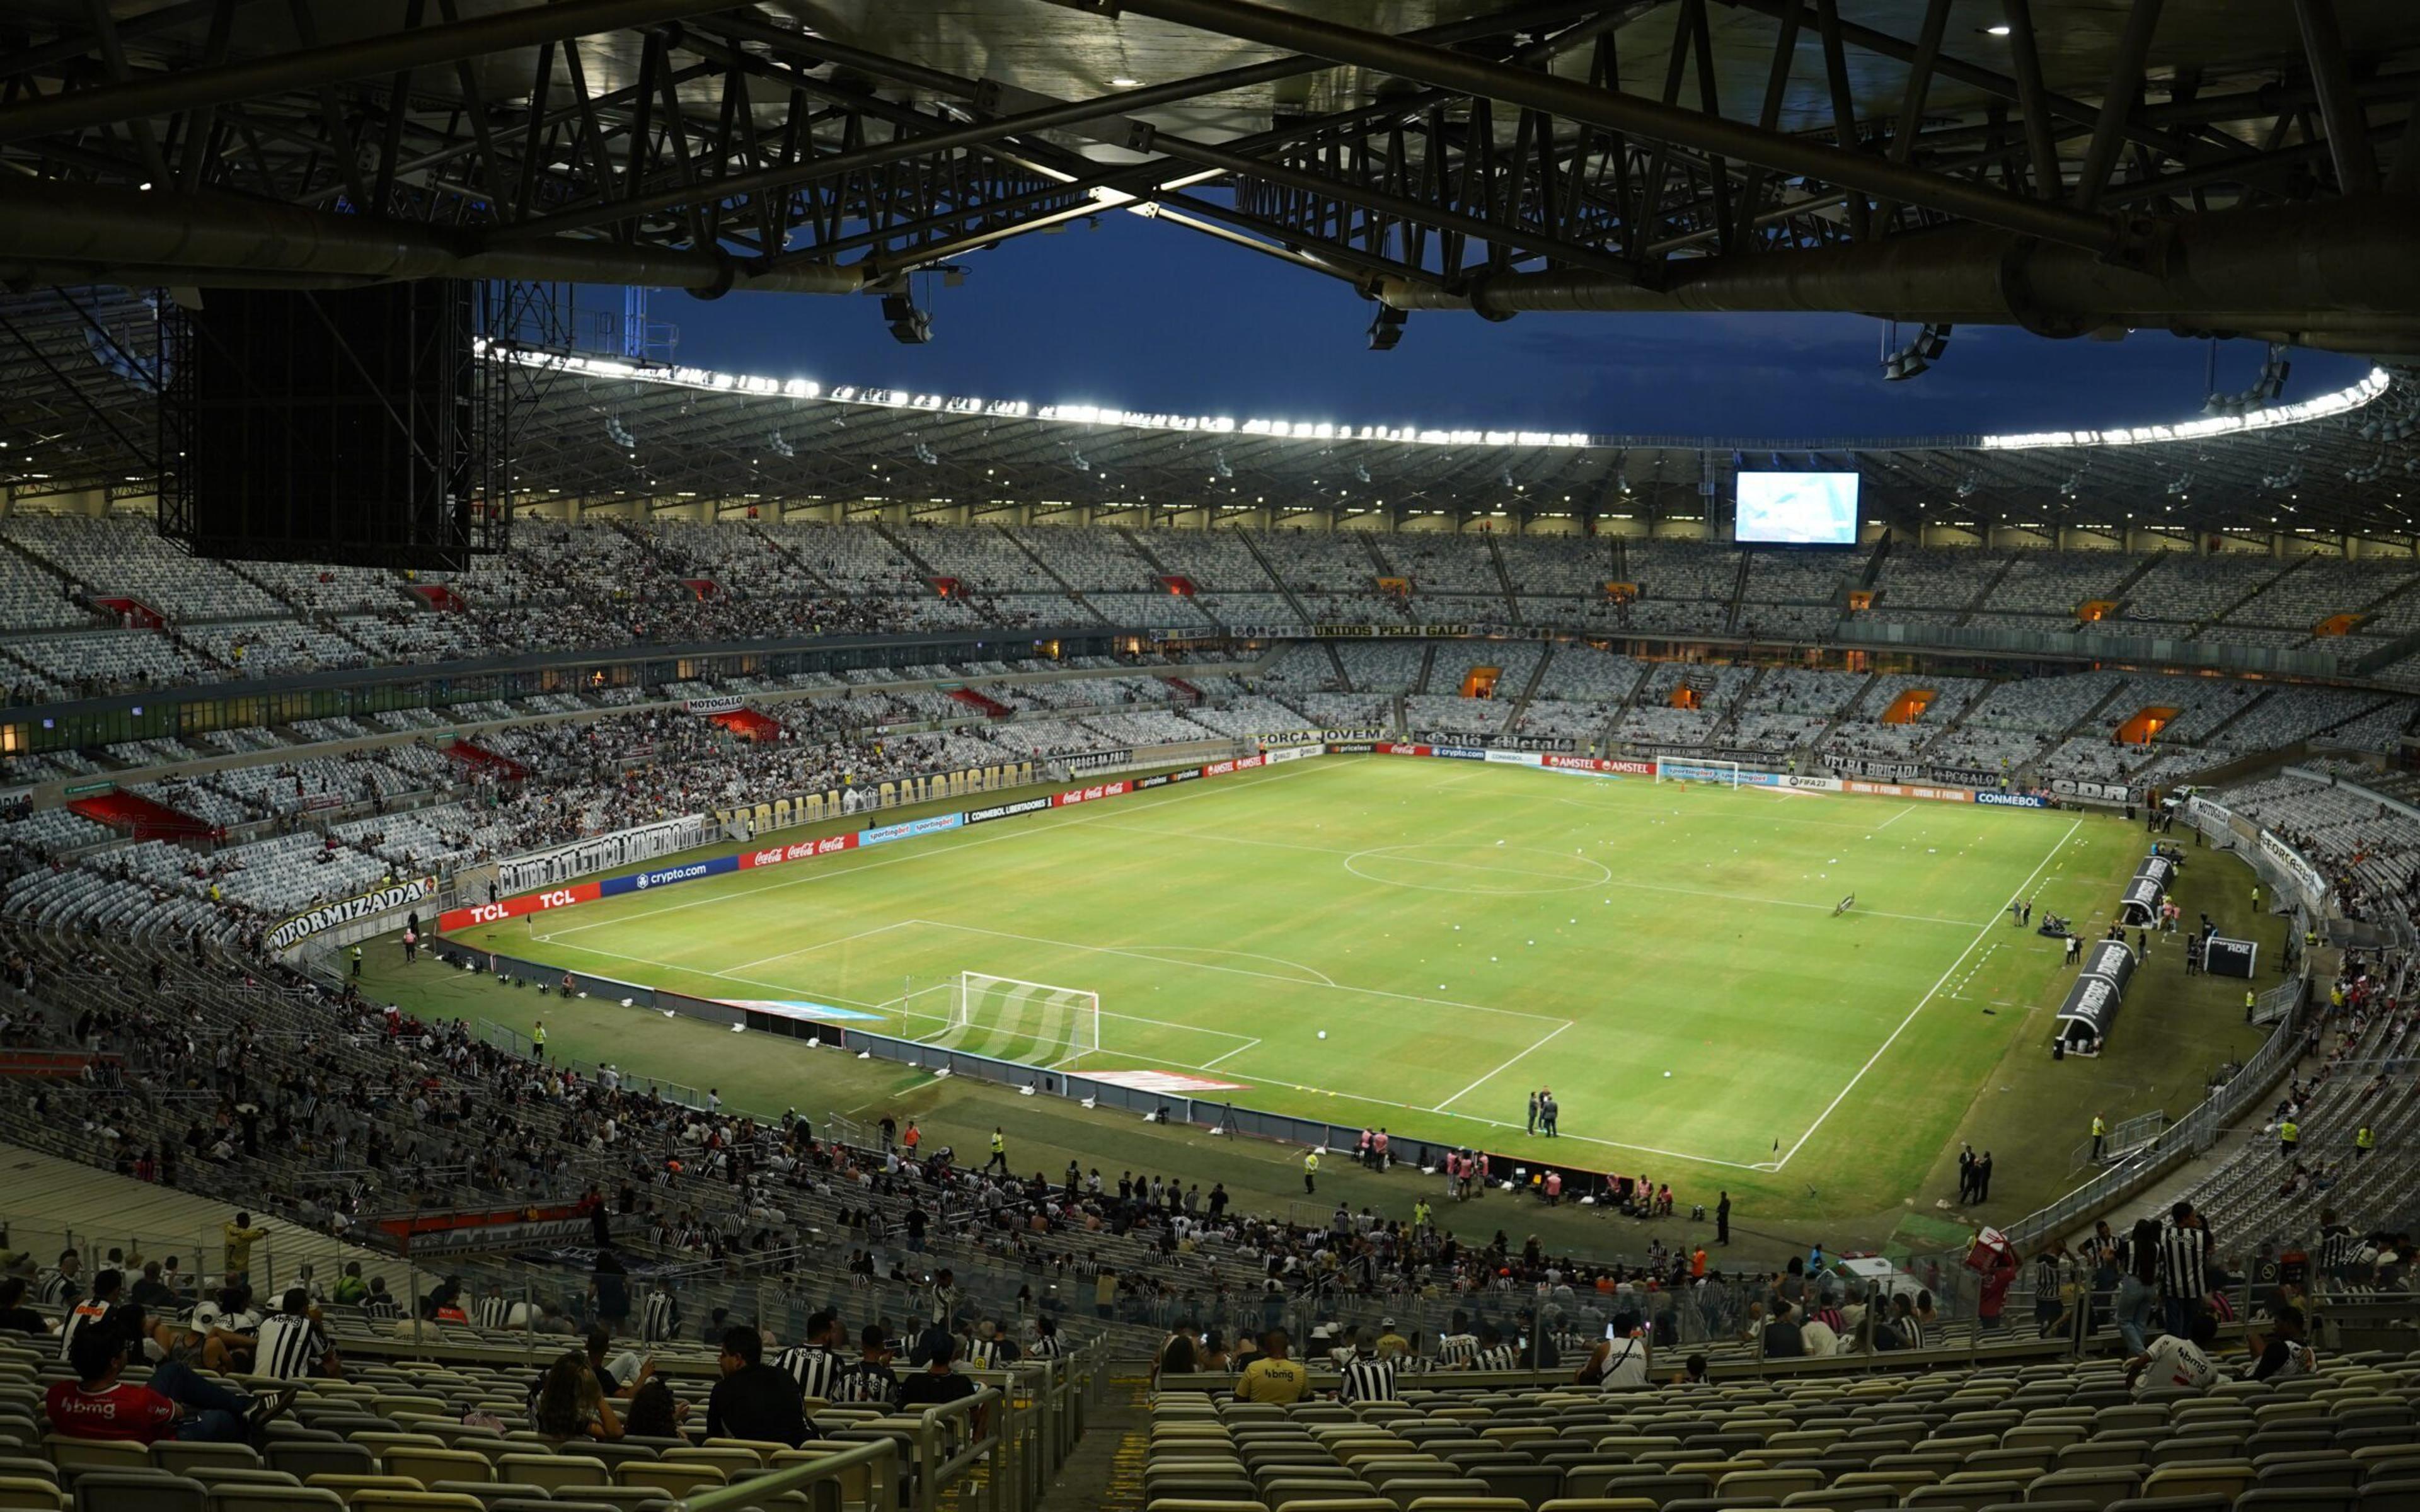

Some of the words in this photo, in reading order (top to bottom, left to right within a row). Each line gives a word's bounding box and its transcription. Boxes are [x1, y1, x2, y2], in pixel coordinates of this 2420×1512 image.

[1313, 626, 1373, 636] UNIDOS
[1378, 626, 1419, 636] PELO
[1426, 625, 1468, 636] GALO
[689, 696, 743, 709] MOTOGALO
[1317, 728, 1381, 744] JOVEM
[1340, 744, 1373, 753] priceless
[1441, 748, 1484, 759] crypto.com
[1214, 762, 1233, 774] AMSTEL
[1242, 757, 1261, 770] AMSTEL
[1559, 758, 1596, 769] AMSTEL
[1611, 762, 1648, 774] AMSTEL
[1824, 754, 1862, 774] VELHA
[1867, 762, 1920, 779] BRIGADA
[1144, 776, 1167, 787] priceless
[1177, 769, 1199, 781] priceless
[1978, 793, 2042, 807] CONMEBOL
[971, 808, 1006, 821] CONMEBOL
[1006, 799, 1046, 815] LIBERTADORES
[916, 817, 954, 832] sportingbet
[870, 825, 910, 840] sportingbet
[623, 822, 681, 864] MINEIRO
[819, 836, 845, 853] Coca-Cola
[755, 849, 782, 866] Coca-Cola
[787, 842, 814, 859] Coca-Cola
[651, 865, 706, 884] crypto.com
[540, 890, 575, 908] TCL
[471, 903, 509, 923] TCL
[279, 1316, 302, 1328] bmg
[801, 1349, 823, 1363] bmg
[2184, 1351, 2208, 1374] bmg
[1272, 1369, 1294, 1382] bmg
[858, 1377, 880, 1390] bmg
[74, 1397, 116, 1419] bmg
